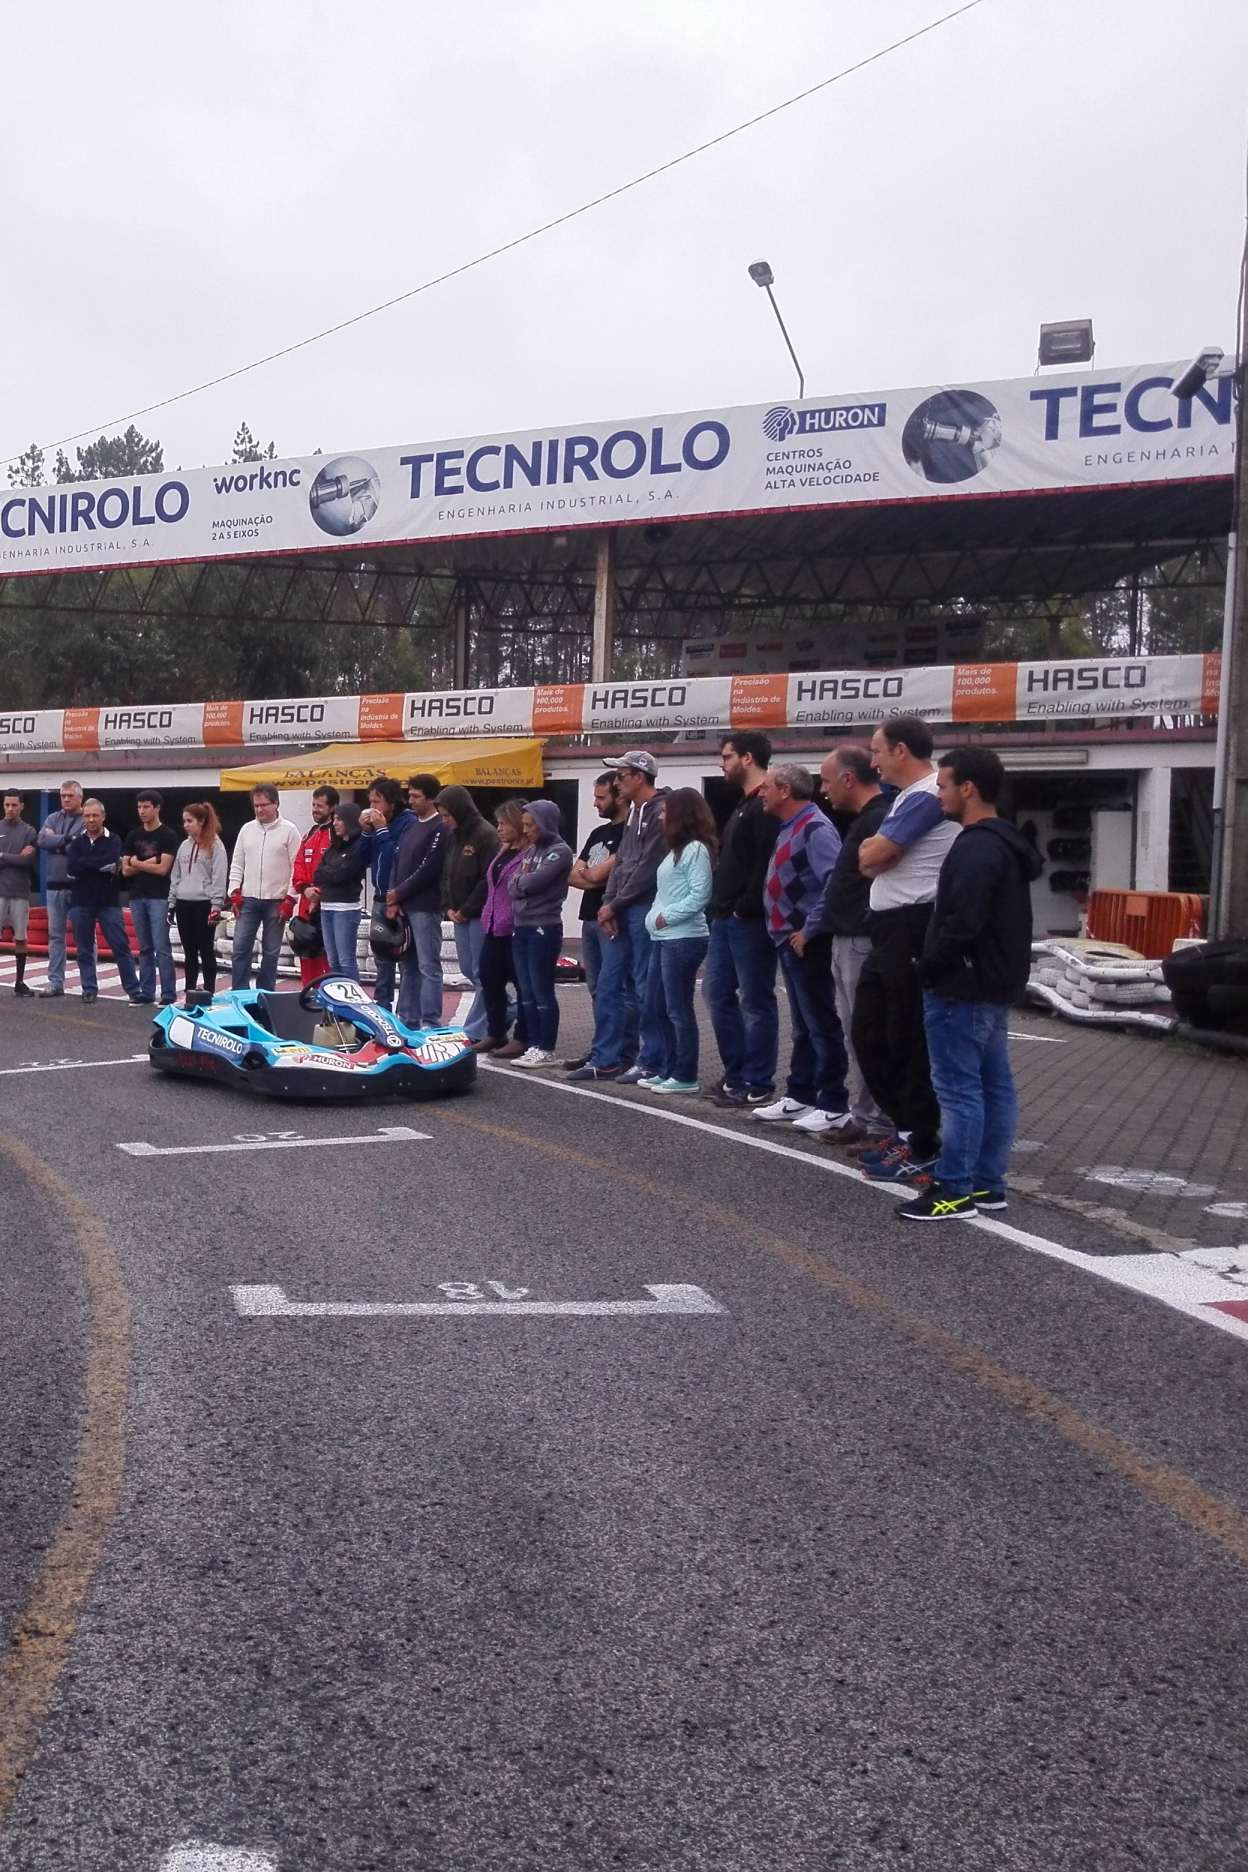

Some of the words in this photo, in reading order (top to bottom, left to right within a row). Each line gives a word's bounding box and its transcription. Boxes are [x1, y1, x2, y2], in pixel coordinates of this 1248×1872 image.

[1029, 376, 1232, 441] TECN
[805, 407, 879, 431] HURON
[400, 420, 731, 499] TECNIROLO
[766, 448, 823, 462] CENTROS
[1084, 444, 1219, 467] ENGENHARIA
[765, 459, 852, 476] MAQUINAÇÃO
[213, 465, 301, 495] worknc
[764, 479, 796, 491] ALTA
[799, 472, 880, 487] VELOCIDADE
[438, 503, 532, 521] ENGENHARIA
[540, 493, 640, 510] INDUSTRIAL,
[212, 514, 273, 528] MAQUINAÇÃO
[212, 533, 217, 541] 2
[219, 532, 225, 540] A
[233, 529, 259, 539] EIXOS
[979, 667, 992, 675] de
[1027, 665, 1147, 692] HASCO
[591, 686, 687, 710] HASCO
[797, 677, 903, 701] HASCO
[250, 704, 325, 725] HASCO
[410, 695, 495, 718] HASCO
[796, 709, 853, 723] Enabling
[858, 707, 885, 720] with
[1027, 701, 1091, 714] Enabling
[1095, 699, 1125, 712] with
[104, 711, 173, 730] HASCO
[591, 717, 642, 730] Enabling
[645, 716, 669, 727] with
[250, 732, 290, 742] Enabling
[292, 731, 310, 740] with
[410, 726, 455, 736] Enabling
[458, 725, 479, 734] with
[337, 984, 362, 1000] 24
[197, 1026, 243, 1054] TECNIROLO
[312, 1055, 352, 1069] HURON
[438, 1280, 530, 1300] 18
